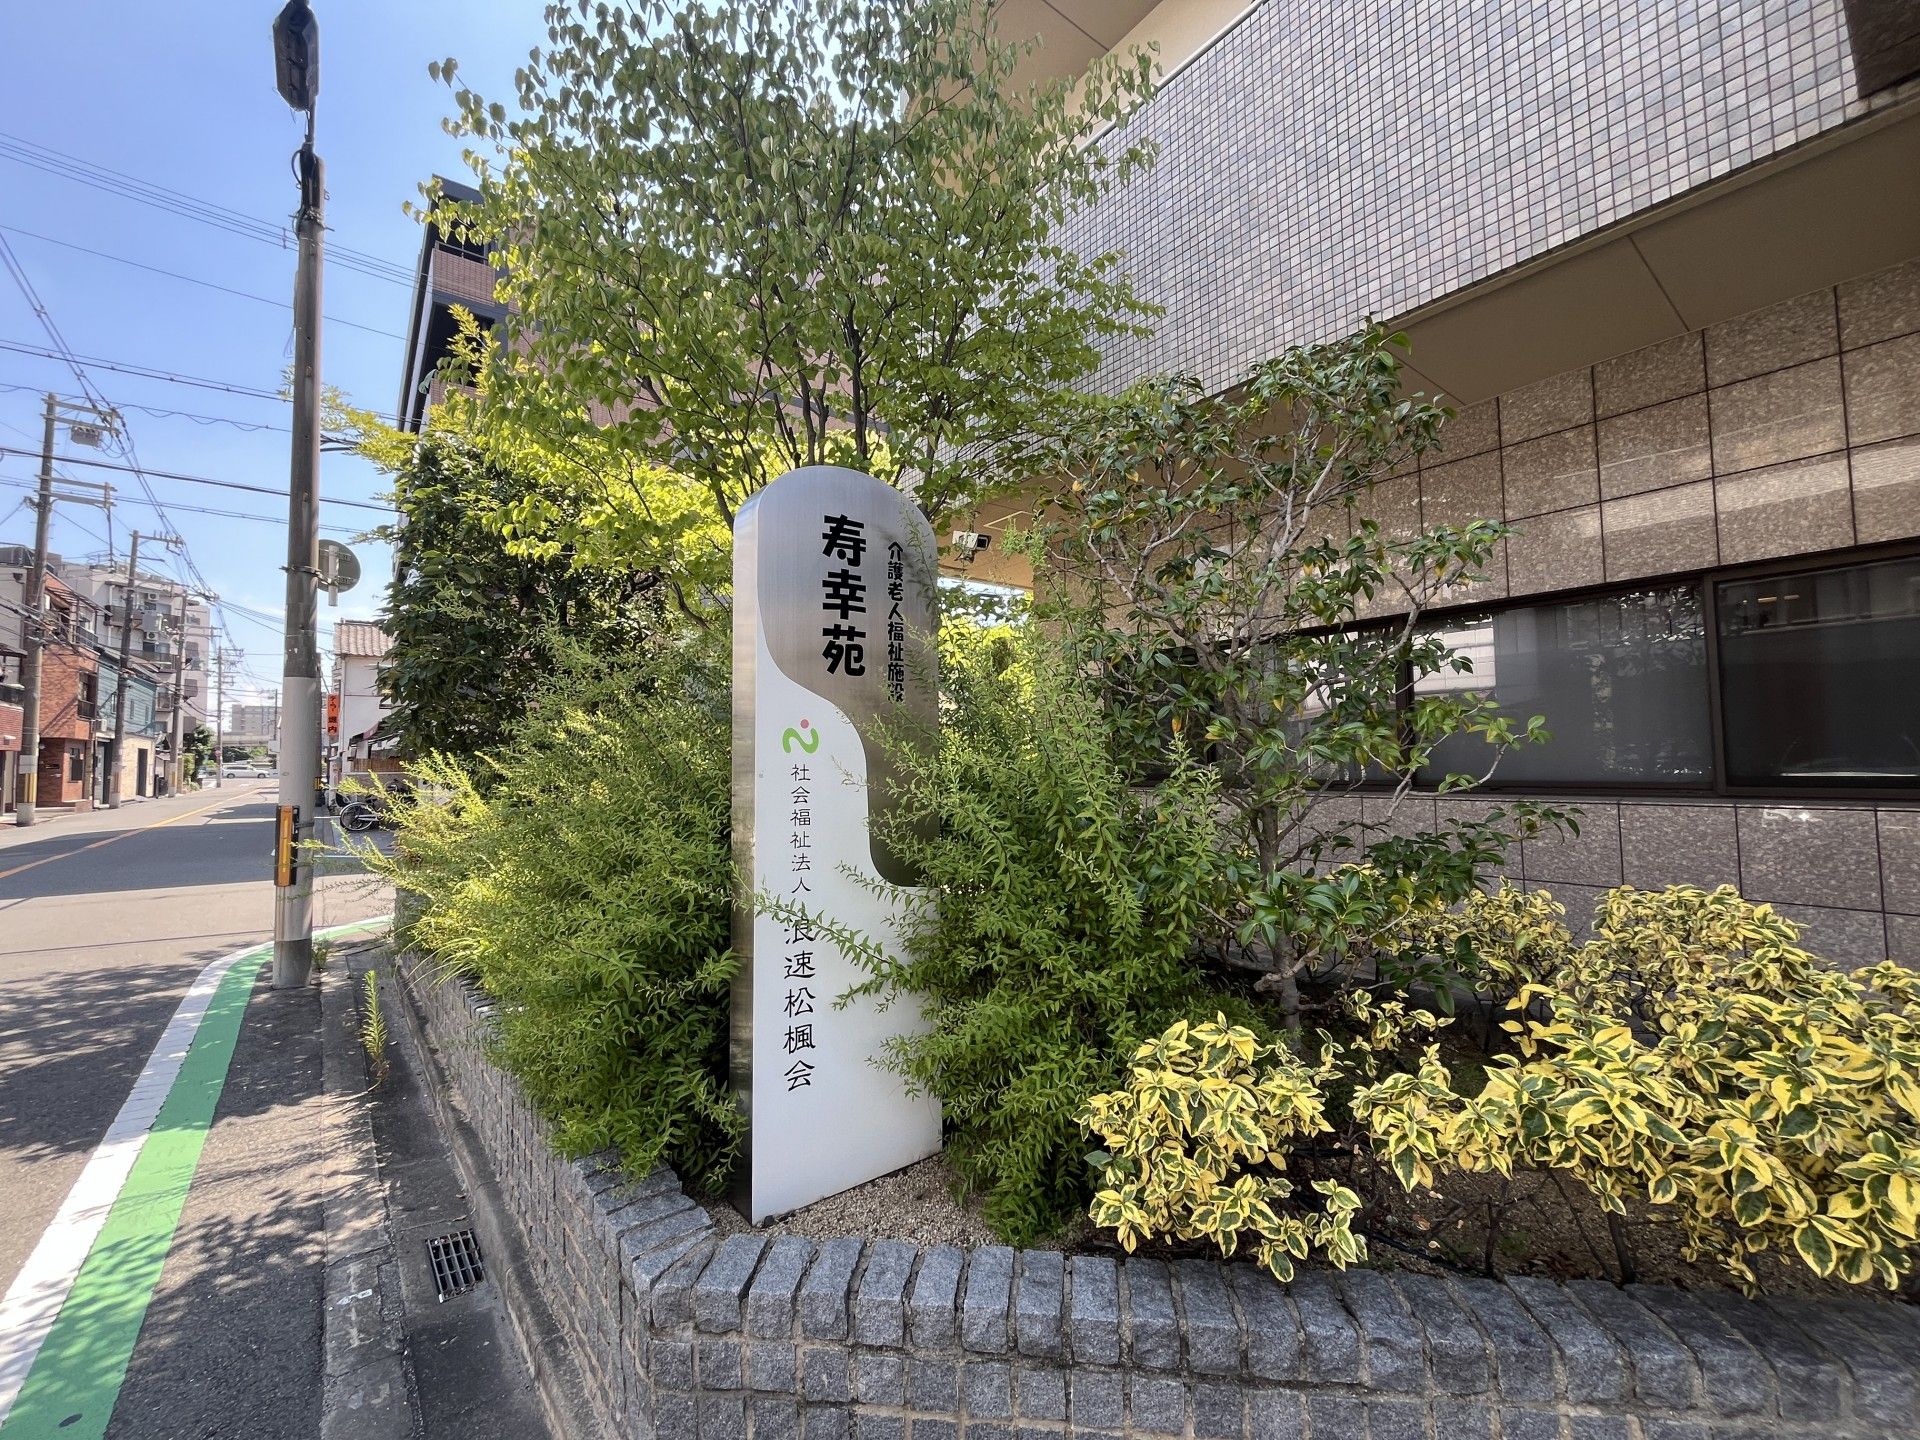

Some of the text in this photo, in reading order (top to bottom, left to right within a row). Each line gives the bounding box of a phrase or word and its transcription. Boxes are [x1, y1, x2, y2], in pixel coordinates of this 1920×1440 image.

[822, 514, 867, 677] 寿幸苑
[783, 763, 817, 1092] 社会福祉法人 浪速松楓会
